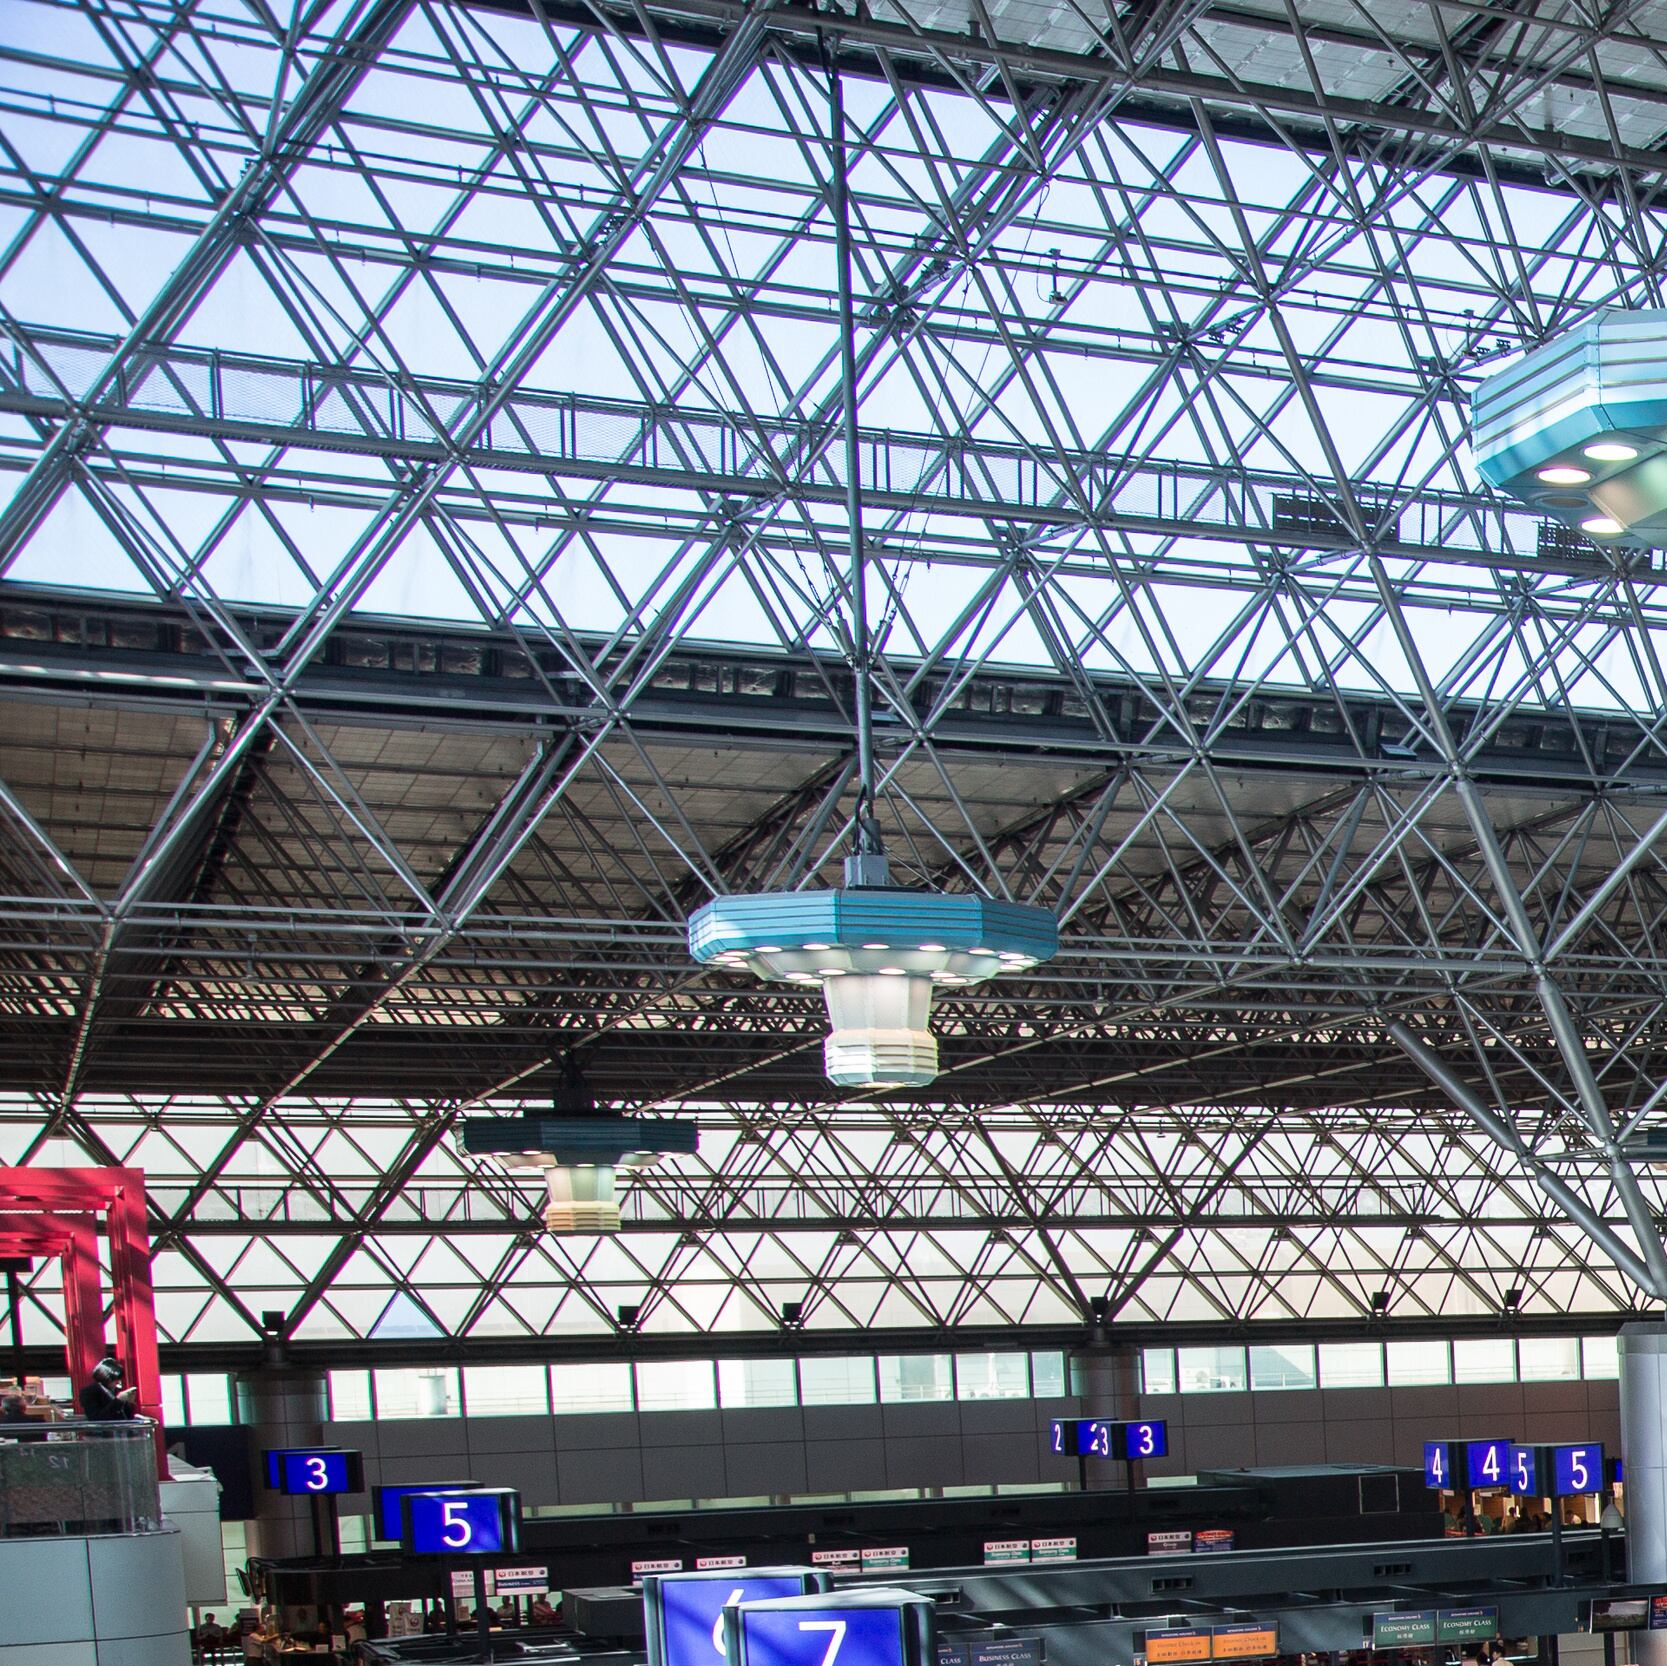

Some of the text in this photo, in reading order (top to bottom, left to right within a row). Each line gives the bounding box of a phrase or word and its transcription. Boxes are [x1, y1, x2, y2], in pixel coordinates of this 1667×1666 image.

[1054, 1423, 1062, 1451] 2
[1101, 1426, 1109, 1456] 3
[1139, 1425, 1154, 1455] 3
[307, 1457, 329, 1490] 3
[1432, 1447, 1443, 1483] 4
[1482, 1445, 1500, 1482] 4
[1518, 1452, 1528, 1490] 5
[1571, 1450, 1588, 1490] 5
[442, 1502, 472, 1547] 5
[1380, 1624, 1411, 1632] ECONOMY
[1443, 1619, 1492, 1629] ECONOMY CLASS
[940, 1657, 961, 1666] CLASS
[978, 1652, 1032, 1663] BUSINESS CLASS
